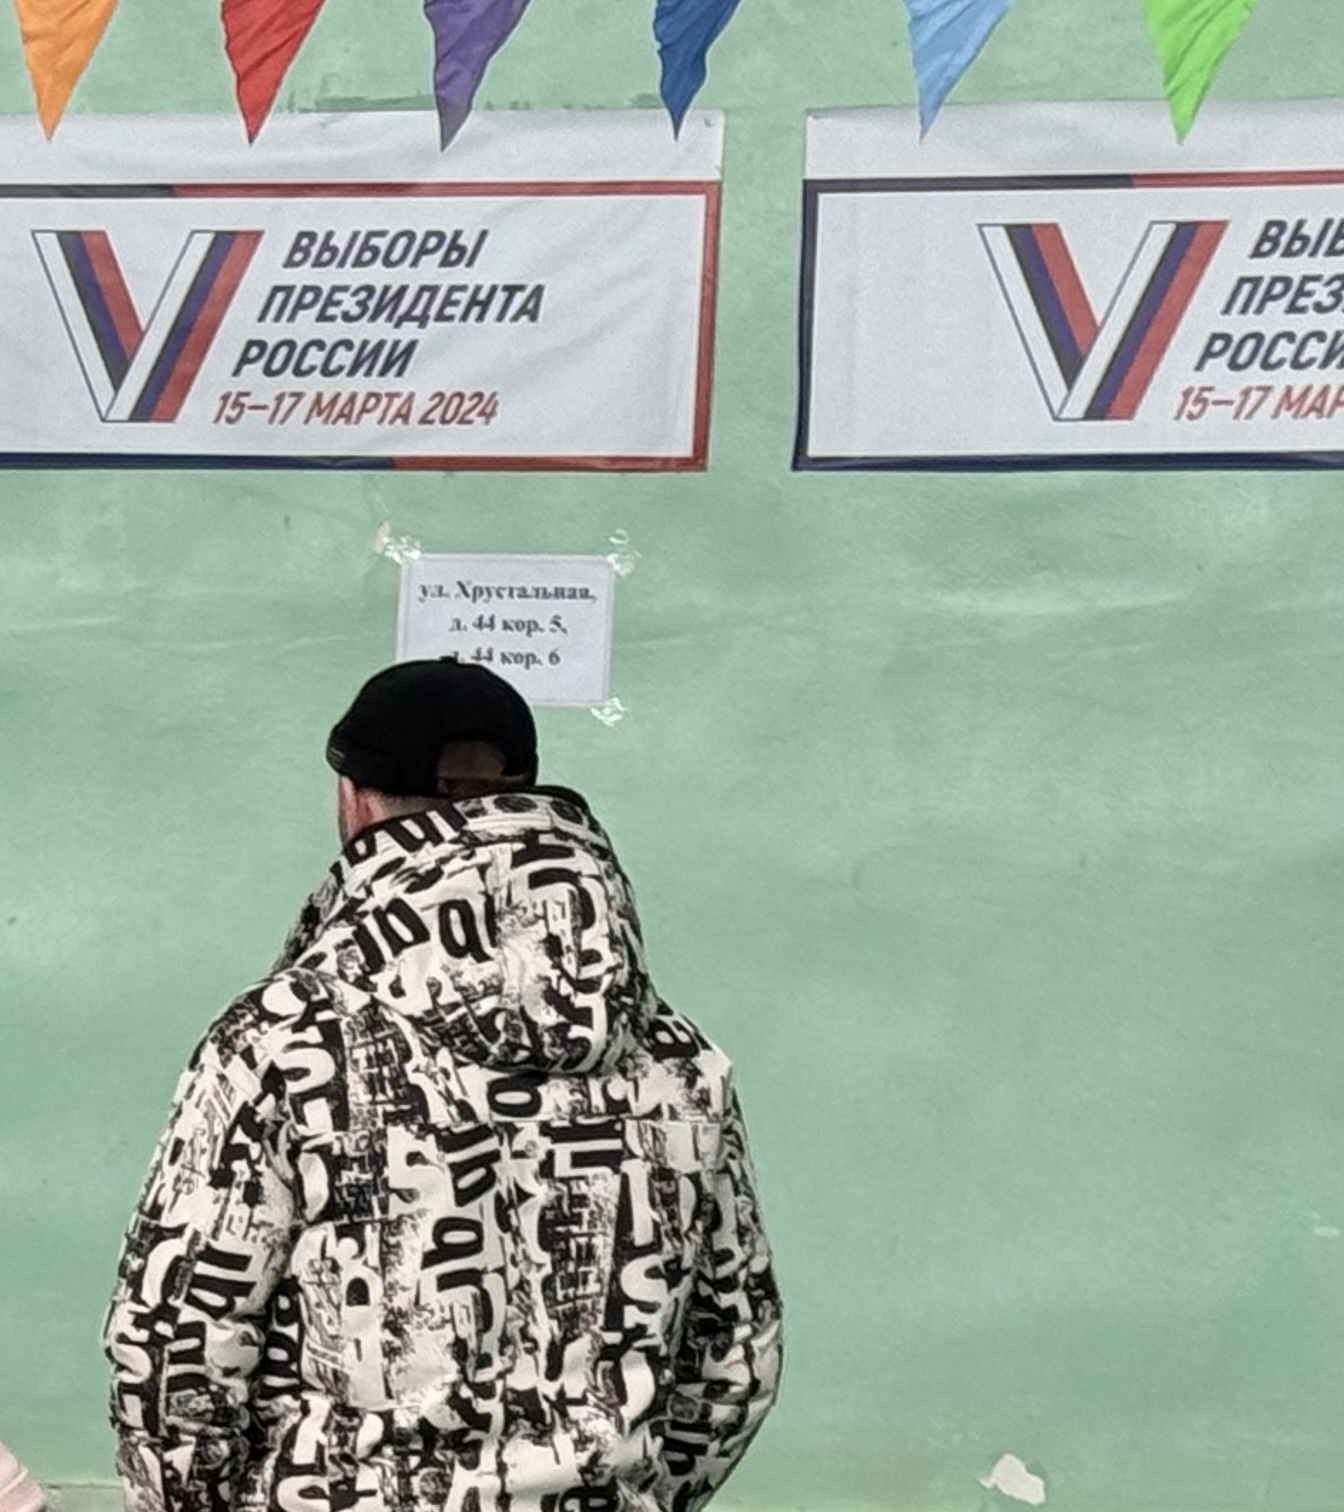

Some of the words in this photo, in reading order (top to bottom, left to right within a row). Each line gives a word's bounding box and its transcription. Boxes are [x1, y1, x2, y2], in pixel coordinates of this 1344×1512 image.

[282, 229, 488, 269] ВЫБОРЫ
[257, 284, 546, 328] ПРЕЗИДЕНТА
[231, 339, 418, 378] РОССИИ
[307, 391, 411, 426] МАРТА
[417, 391, 499, 427] 2024
[418, 584, 450, 604] ул.
[472, 614, 496, 632] 44
[501, 617, 545, 638] кор.
[549, 614, 568, 634] 5,
[470, 646, 494, 665] 44
[500, 650, 542, 670] кор.
[548, 647, 561, 666] 6
